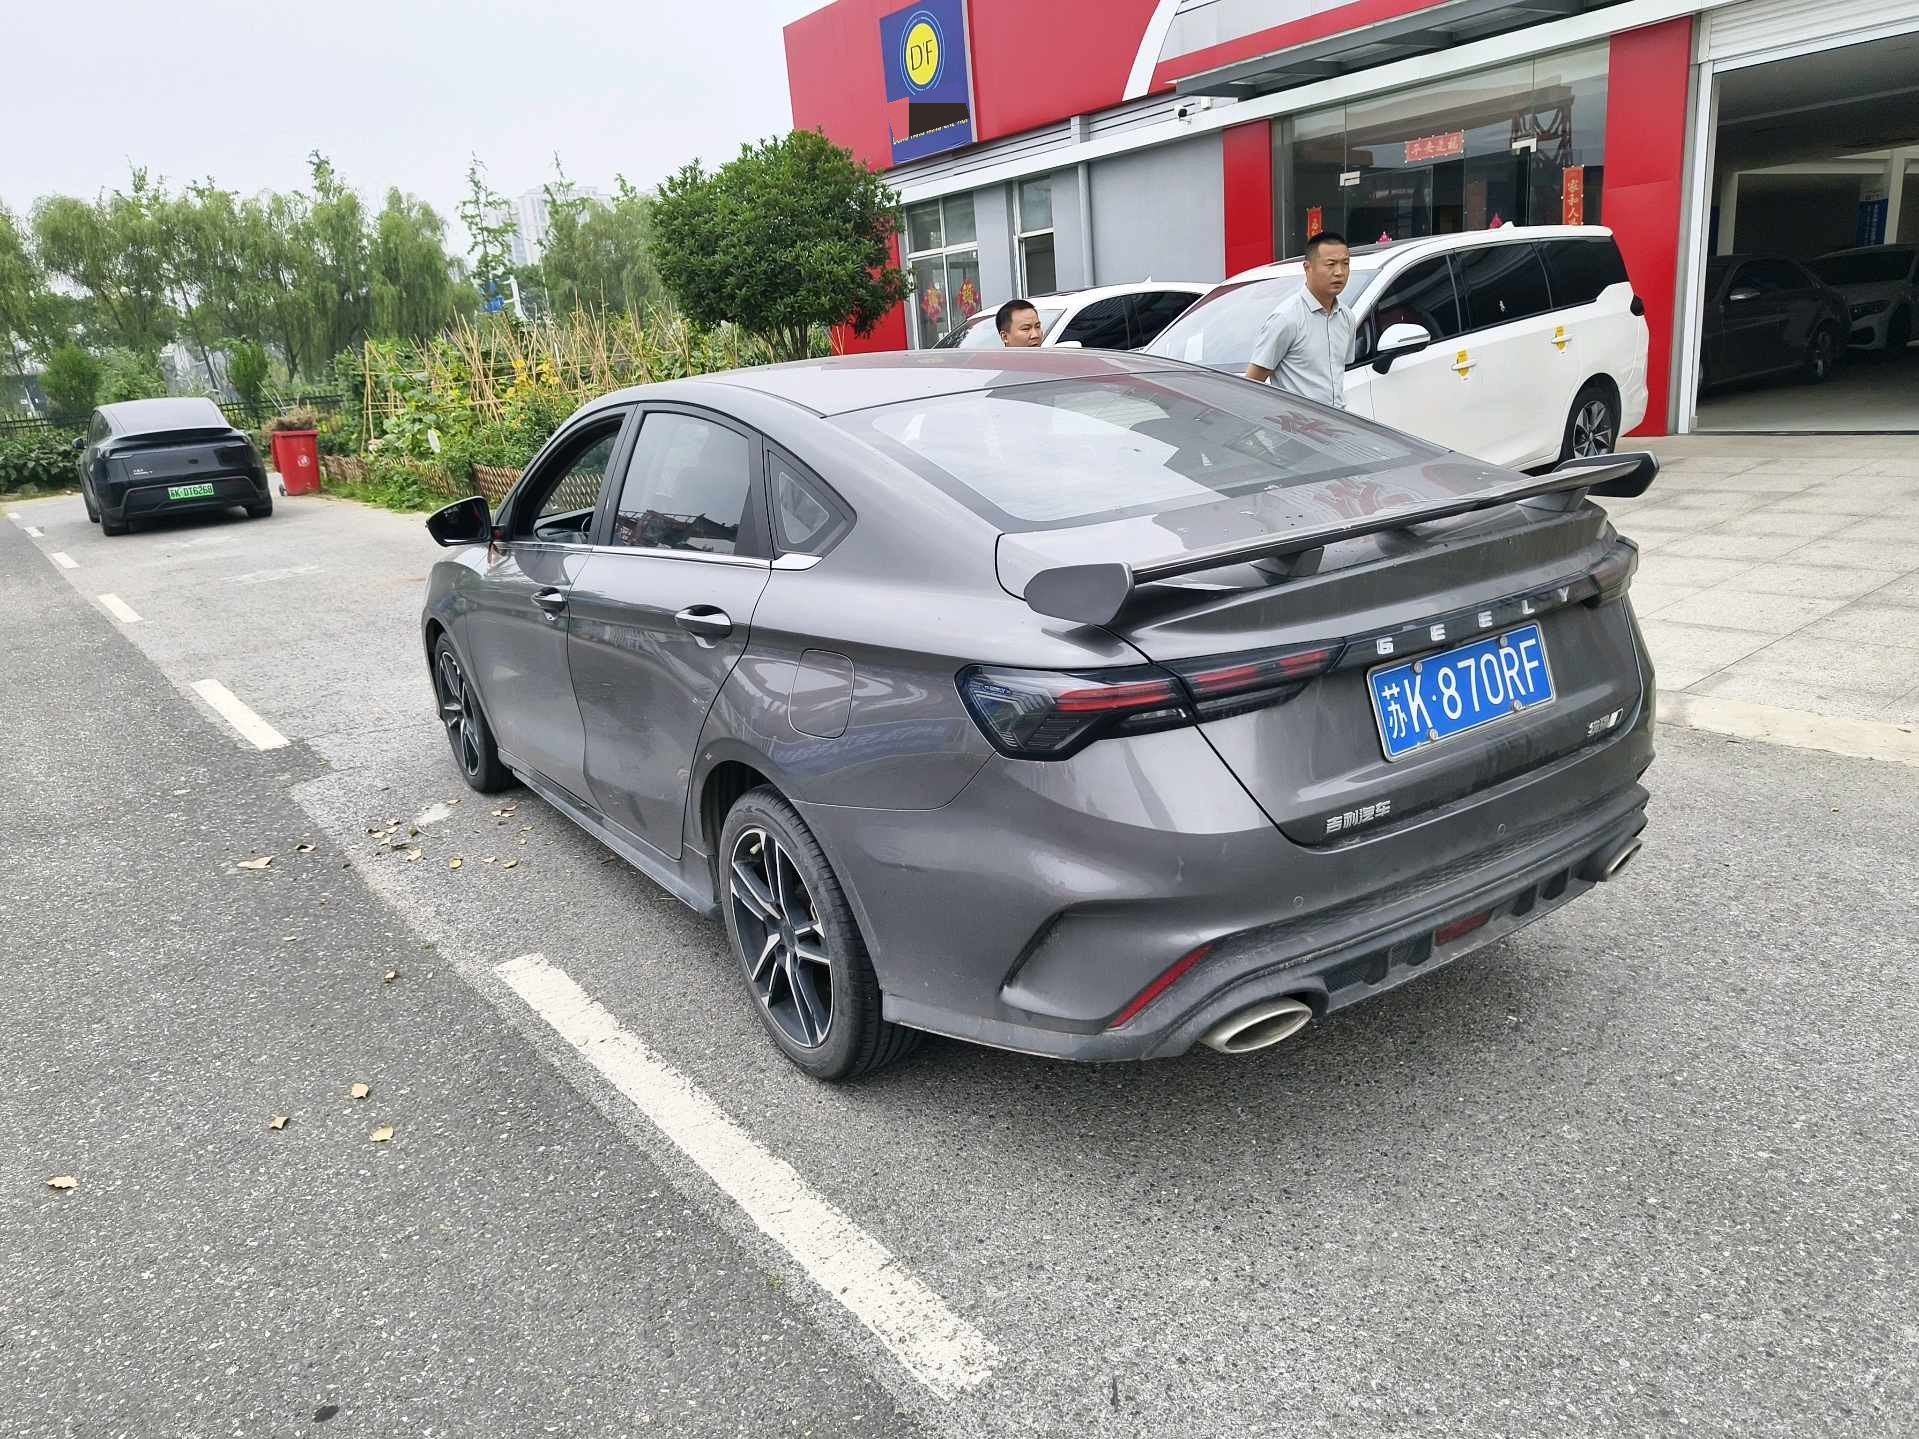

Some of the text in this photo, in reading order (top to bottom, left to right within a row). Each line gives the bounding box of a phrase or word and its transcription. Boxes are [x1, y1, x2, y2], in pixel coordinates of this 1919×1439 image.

[1376, 587, 1572, 655] GEELY
[1381, 637, 1540, 740] 苏K·870RF
[1326, 799, 1391, 834] 吉利汽车
